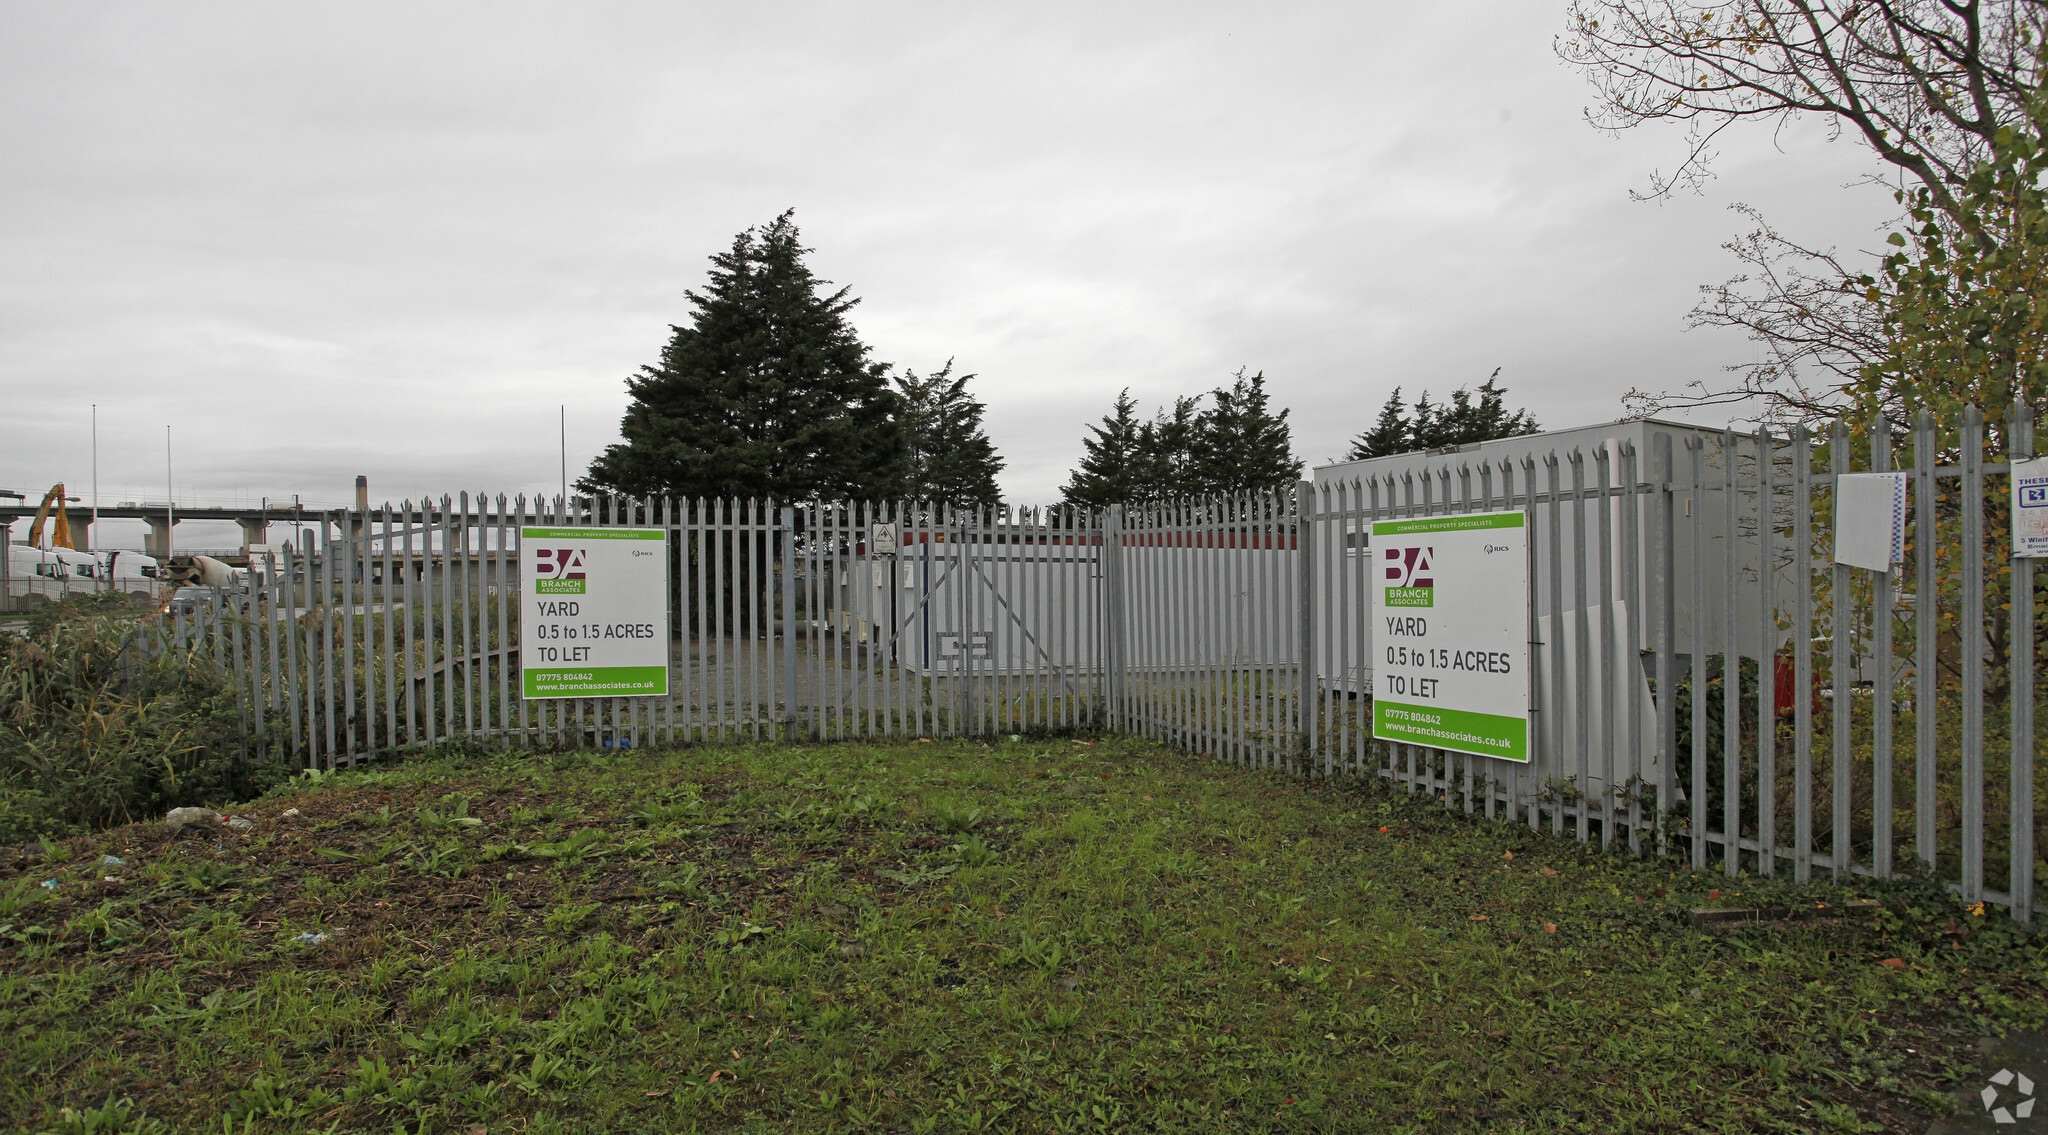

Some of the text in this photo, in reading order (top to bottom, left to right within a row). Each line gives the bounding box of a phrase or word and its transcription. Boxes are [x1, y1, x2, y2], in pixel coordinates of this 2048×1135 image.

[1430, 522, 1456, 530] PROPERTY
[536, 549, 586, 579] BA
[1385, 547, 1433, 588] BA
[541, 580, 581, 588] BRANCH
[1389, 589, 1428, 598] BRANCH
[537, 601, 579, 616] YARD
[538, 624, 654, 639] 0.5 to 1.5 ACRES
[1386, 616, 1427, 636] YARD
[538, 646, 591, 661] TO LET
[1387, 646, 1510, 673] 0.5 to 1.5 ACRES
[536, 673, 561, 681] 07775
[536, 681, 654, 690] www.branchassociates.co.uk
[1387, 675, 1438, 698] TO LET
[1385, 709, 1441, 725] 07775 804842
[1385, 721, 1511, 748] www.branchassociates.co.uk
